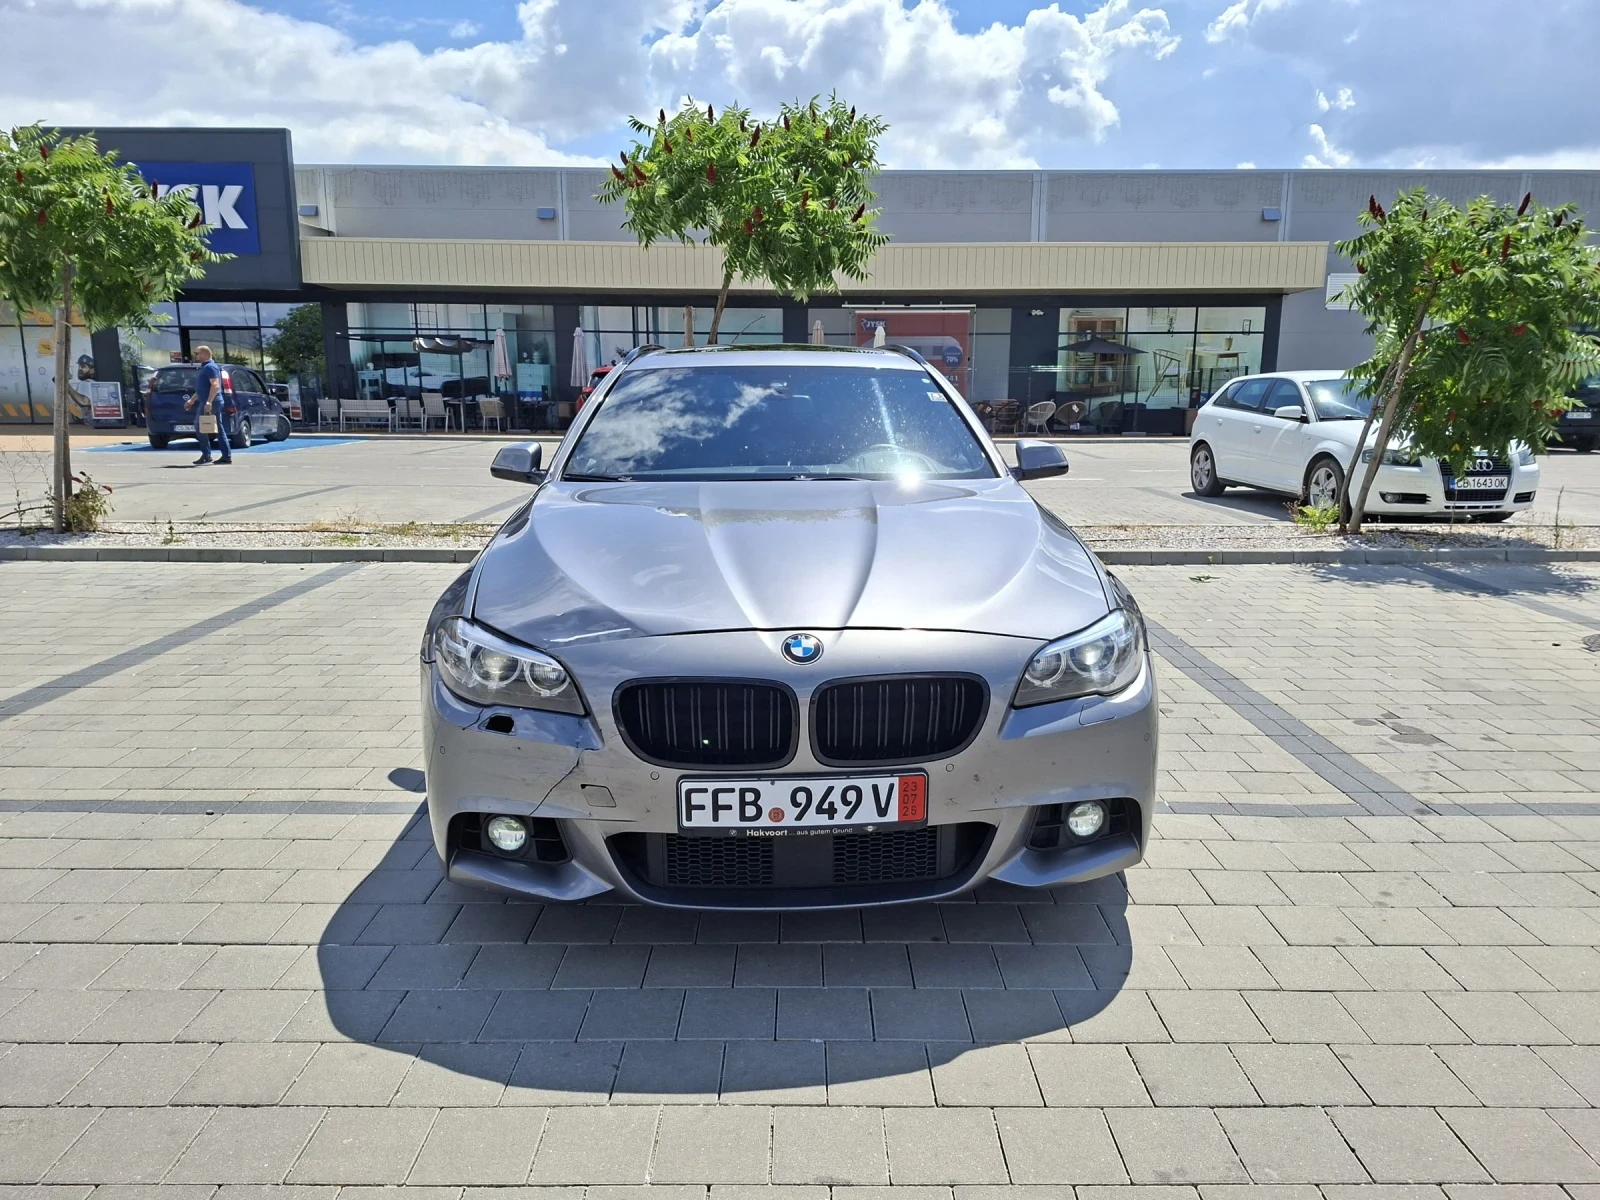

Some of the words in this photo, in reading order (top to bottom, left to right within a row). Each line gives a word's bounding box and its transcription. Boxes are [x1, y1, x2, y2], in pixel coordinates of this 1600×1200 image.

[902, 781, 918, 792] 23
[684, 787, 763, 823] FFB
[789, 784, 863, 822] 949
[871, 782, 895, 818] V
[902, 793, 918, 805] 07
[746, 829, 788, 837] Hakvoort
[810, 829, 831, 837] gutem
